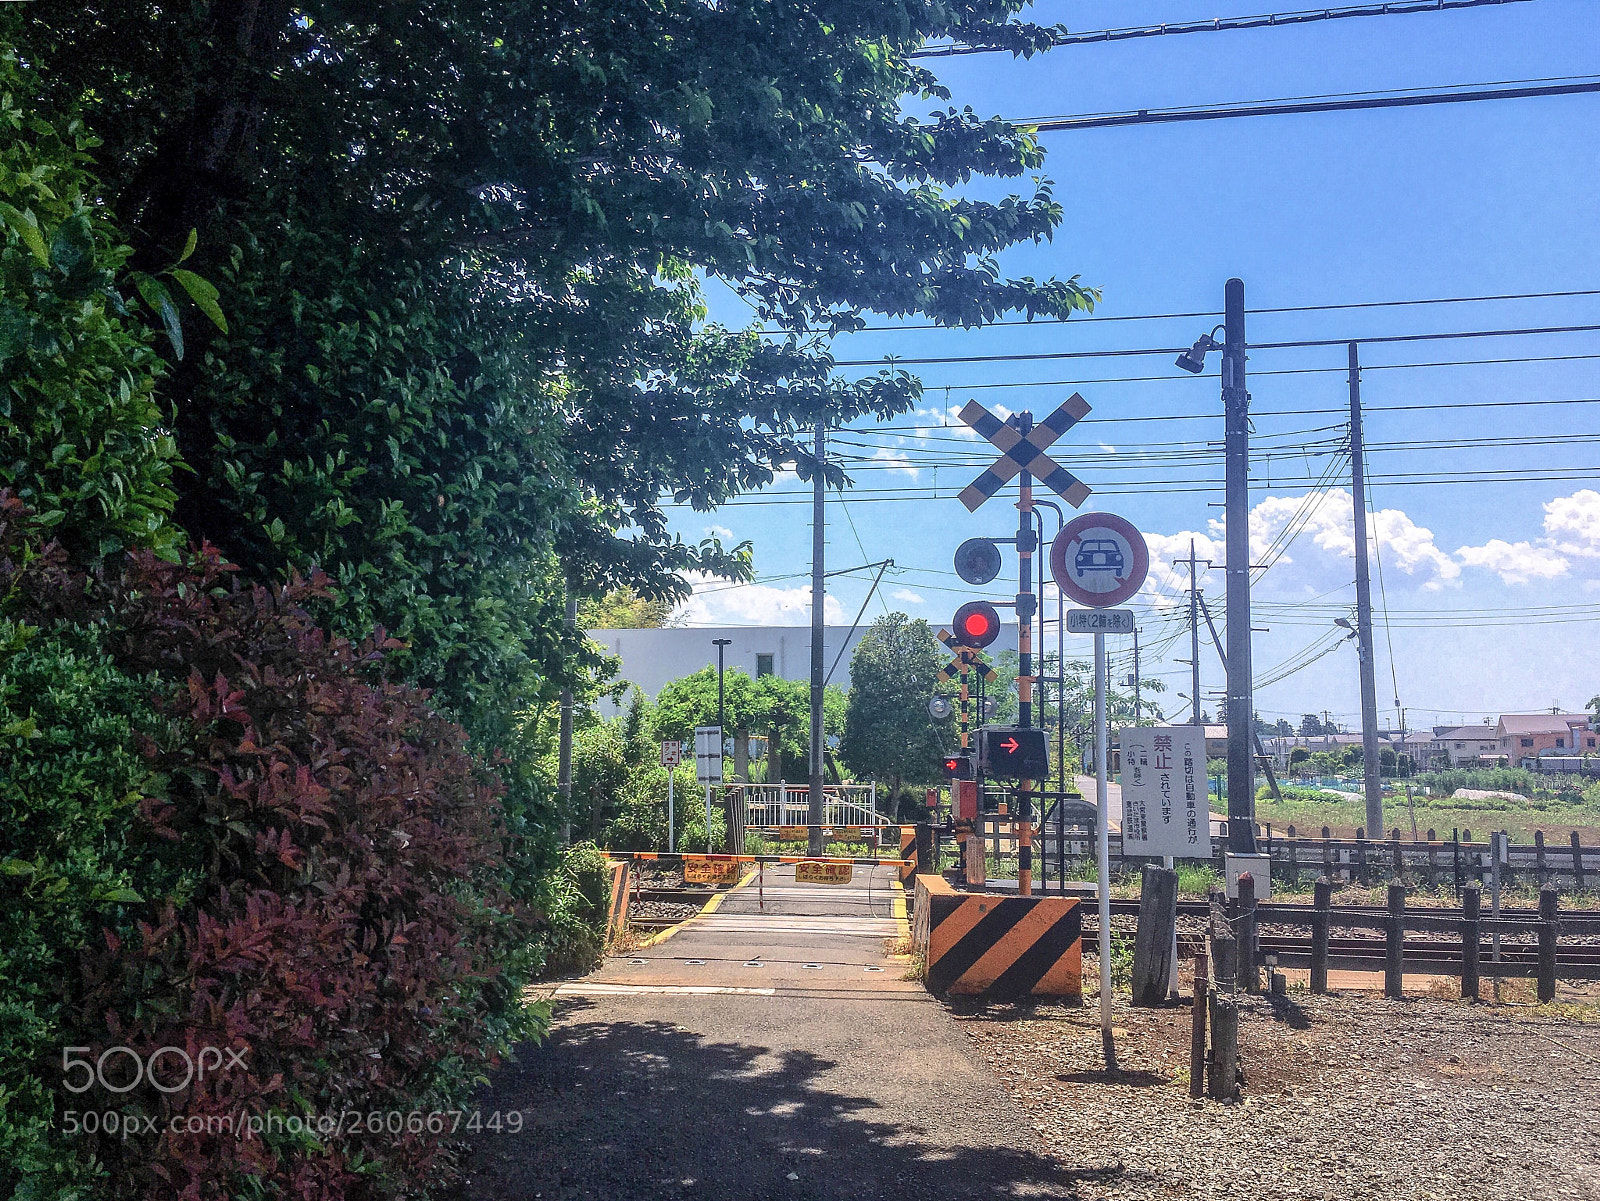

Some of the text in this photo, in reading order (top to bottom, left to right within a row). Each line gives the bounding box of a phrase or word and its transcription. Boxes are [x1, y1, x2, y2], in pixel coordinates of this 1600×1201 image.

[1154, 734, 1173, 825] 禁止されています
[1184, 743, 1198, 844] この踏切は自動車の通行が
[687, 862, 737, 875] 安全確認
[798, 864, 850, 875] 安全確認
